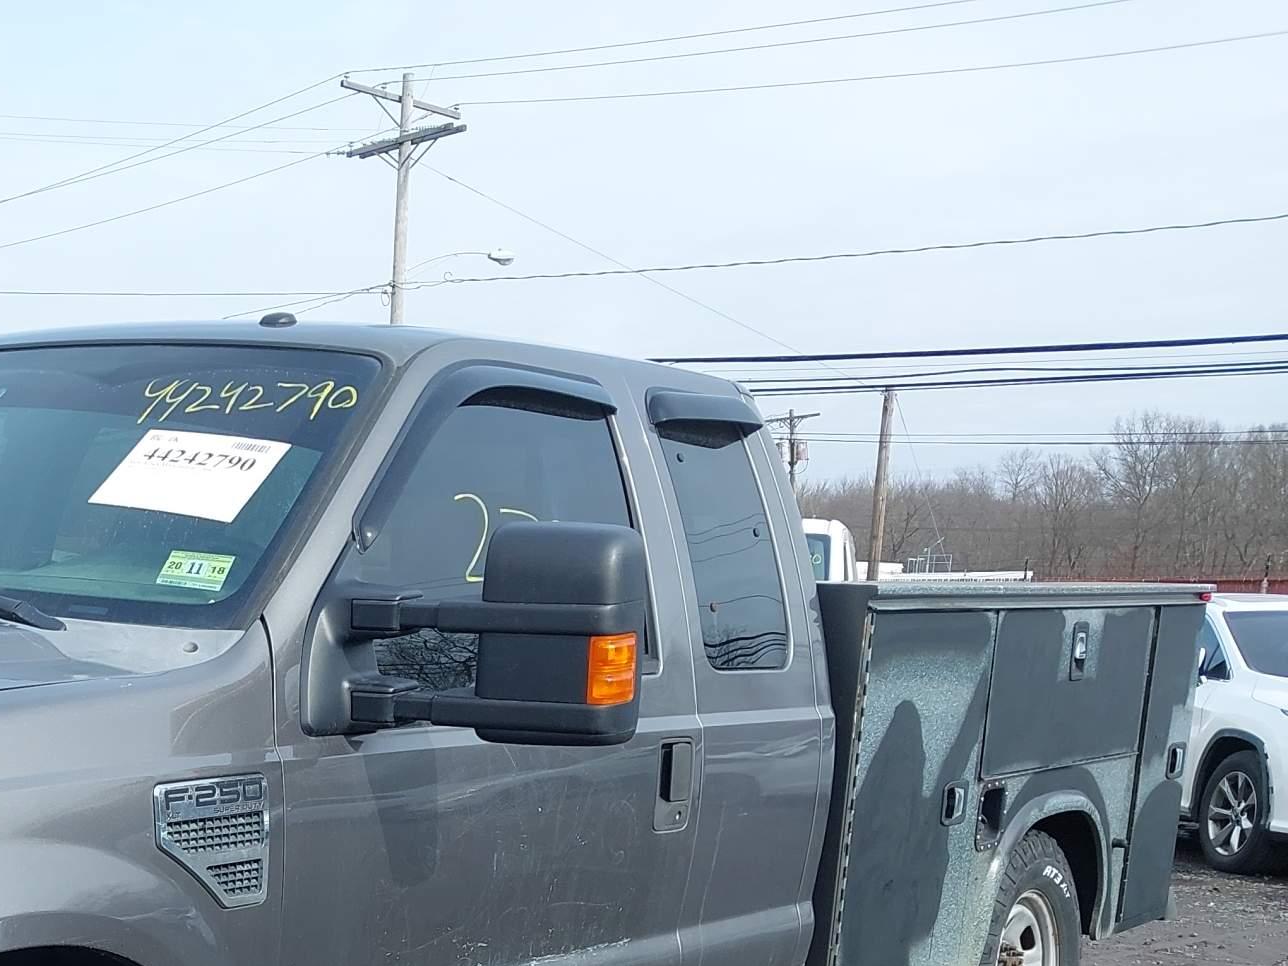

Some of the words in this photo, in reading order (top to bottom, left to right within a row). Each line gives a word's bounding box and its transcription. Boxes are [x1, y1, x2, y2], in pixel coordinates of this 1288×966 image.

[136, 378, 358, 424] 44242790
[143, 447, 257, 472] 44242790
[167, 560, 183, 570] 20
[186, 561, 204, 575] 11
[210, 566, 226, 575] 18
[1042, 865, 1063, 885] AT3
